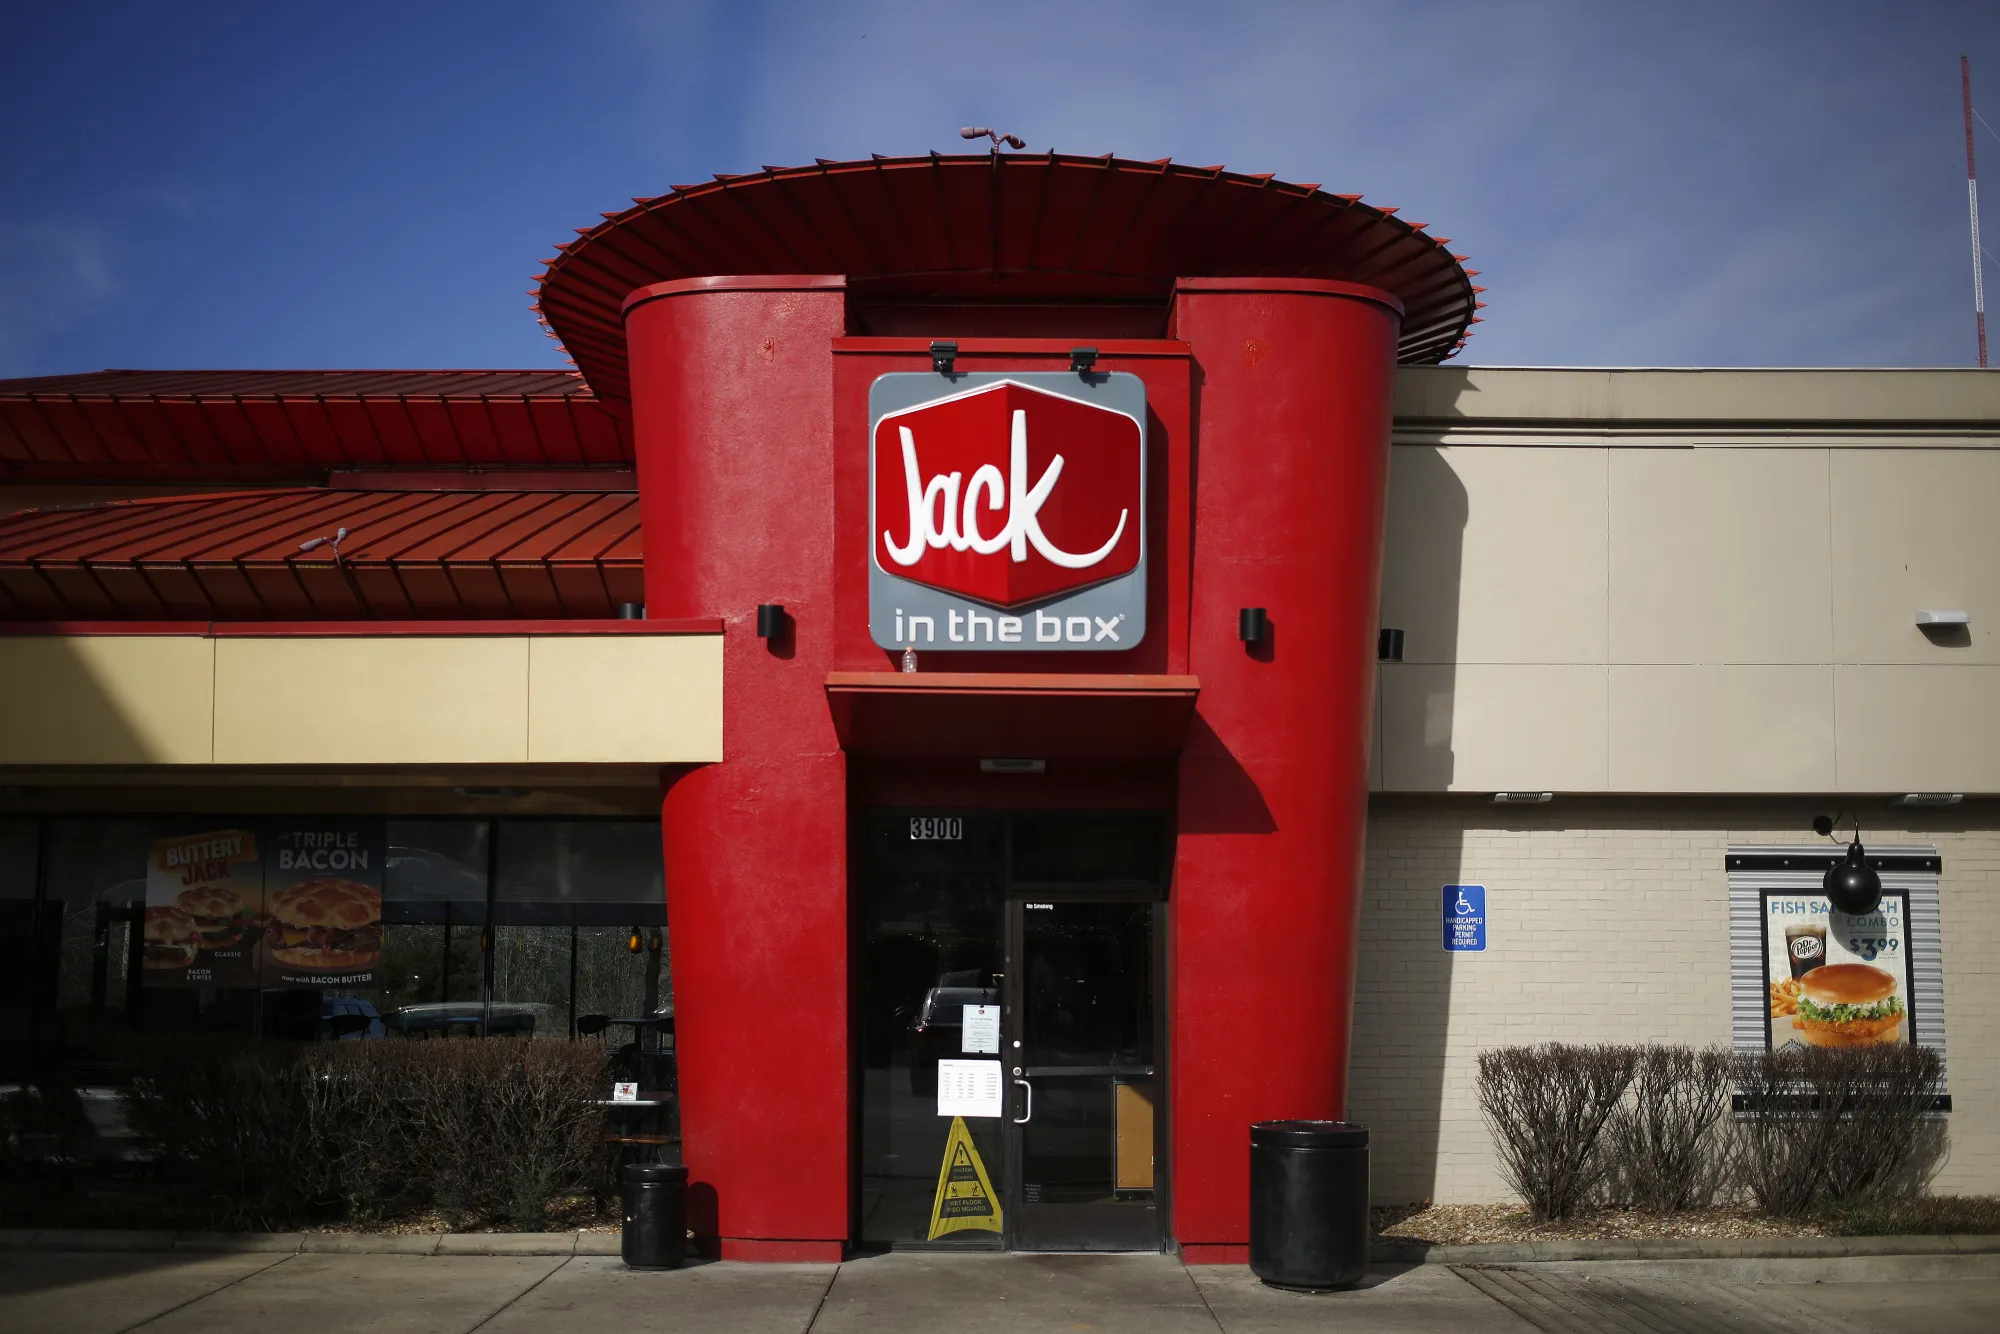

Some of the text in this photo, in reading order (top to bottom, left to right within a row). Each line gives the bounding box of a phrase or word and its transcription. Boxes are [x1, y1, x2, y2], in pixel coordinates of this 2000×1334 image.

[884, 409, 1128, 569] Jack
[895, 608, 935, 643] in
[948, 609, 1023, 643] the
[911, 817, 962, 839] 3900
[292, 831, 358, 848] TRIPLE
[165, 836, 244, 868] BUTTERY
[280, 849, 368, 870] BACON
[181, 860, 231, 885] JACK
[1034, 903, 1054, 911] Smoking
[1771, 901, 1806, 914] FISH
[1847, 916, 1899, 927] COMBO
[1451, 938, 1478, 946] REQUIRED
[1796, 942, 1819, 956] Pepper
[1802, 940, 1812, 948] Dr
[295, 976, 310, 984] with
[311, 976, 340, 984] BACON
[341, 973, 372, 984] BUTTER
